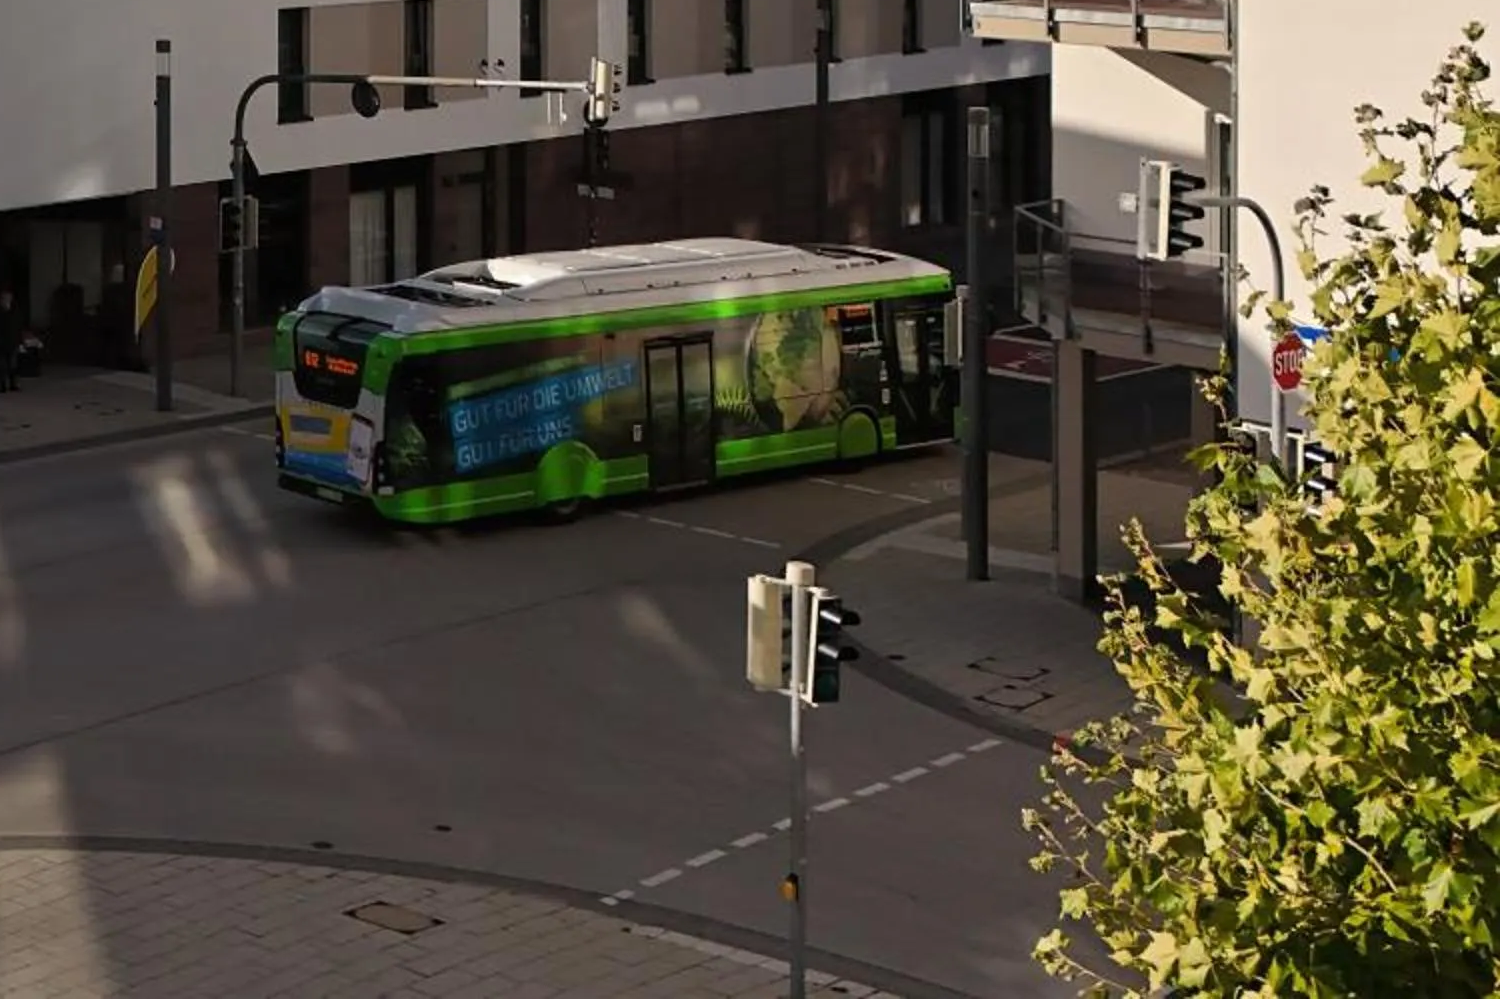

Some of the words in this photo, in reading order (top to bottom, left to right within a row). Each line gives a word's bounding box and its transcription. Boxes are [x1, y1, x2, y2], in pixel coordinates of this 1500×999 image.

[454, 402, 490, 433] GUT
[533, 383, 562, 410] DIE
[564, 362, 633, 401] UMWELT
[537, 415, 573, 443] UNS
